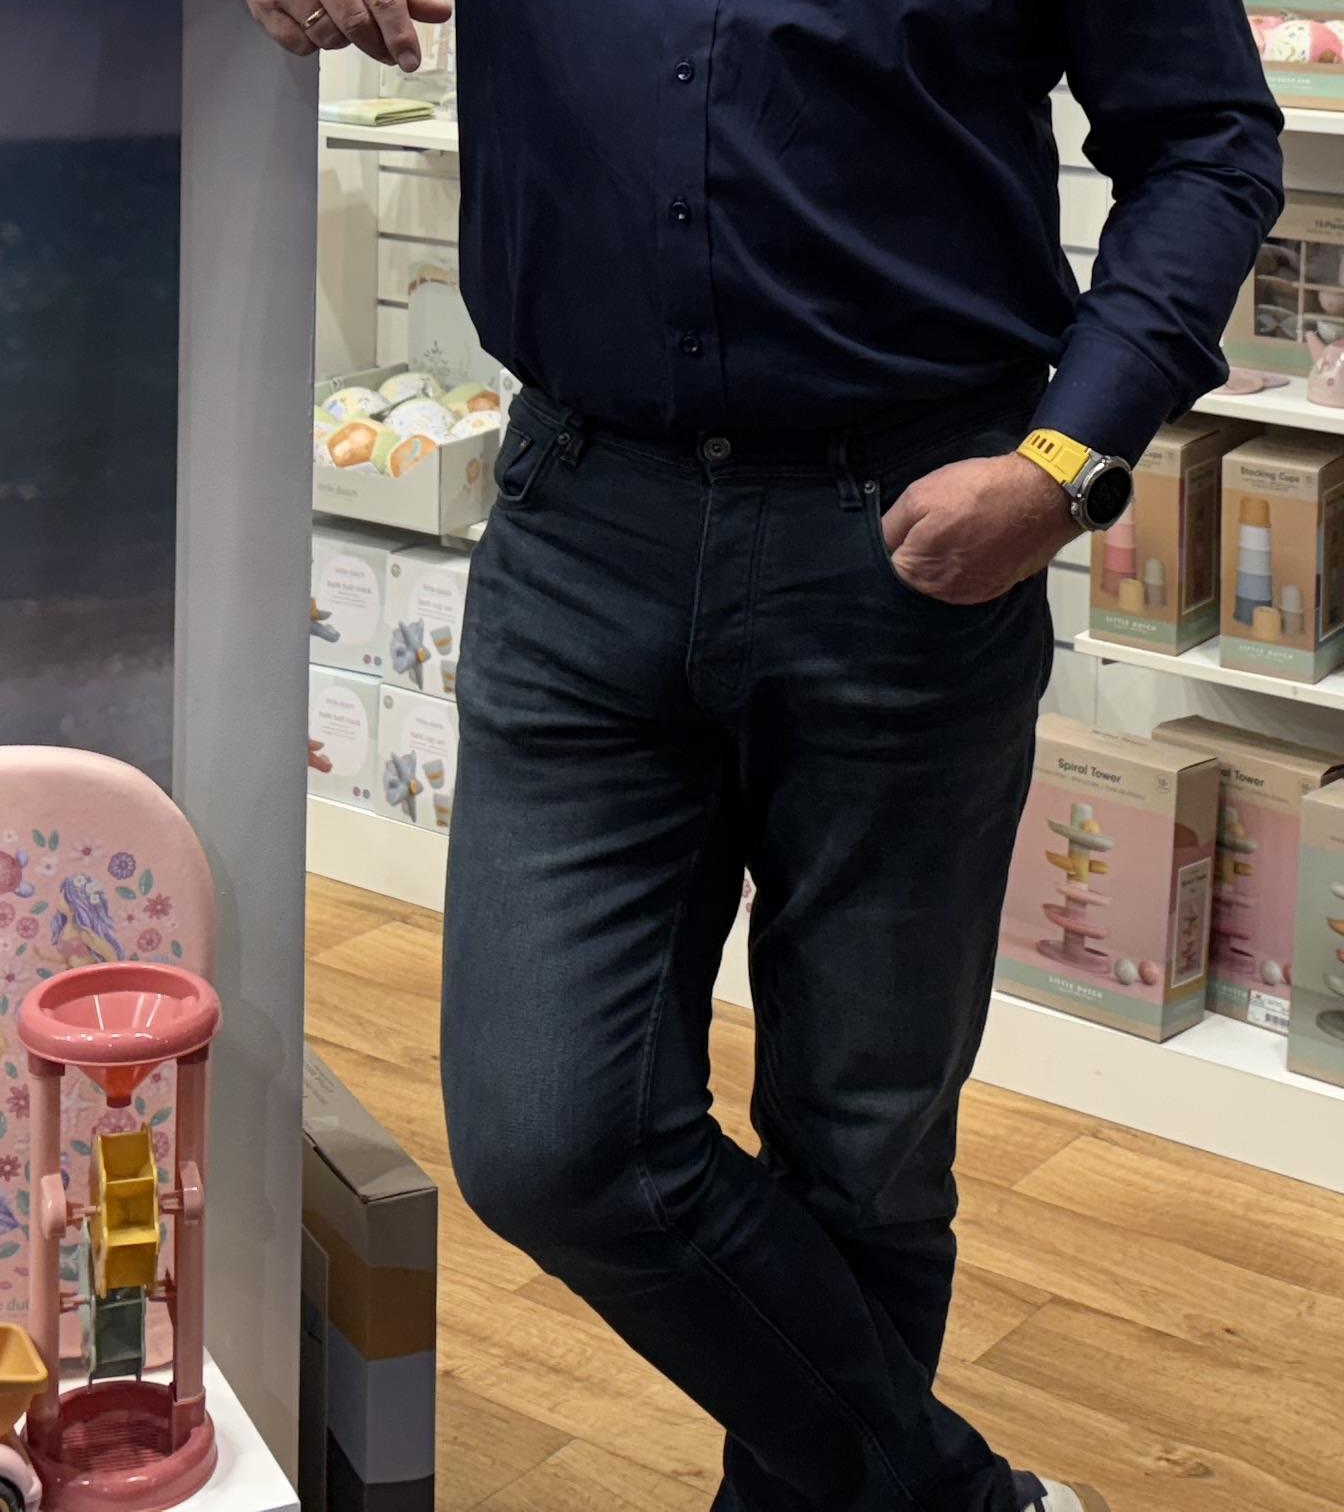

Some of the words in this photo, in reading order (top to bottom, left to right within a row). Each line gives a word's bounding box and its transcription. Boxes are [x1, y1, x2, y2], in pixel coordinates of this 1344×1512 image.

[1239, 467, 1277, 484] Stacking
[1278, 470, 1301, 485] Cups
[1058, 758, 1089, 775] Spiral
[1090, 766, 1122, 784] Tower
[1234, 770, 1265, 788] Tower
